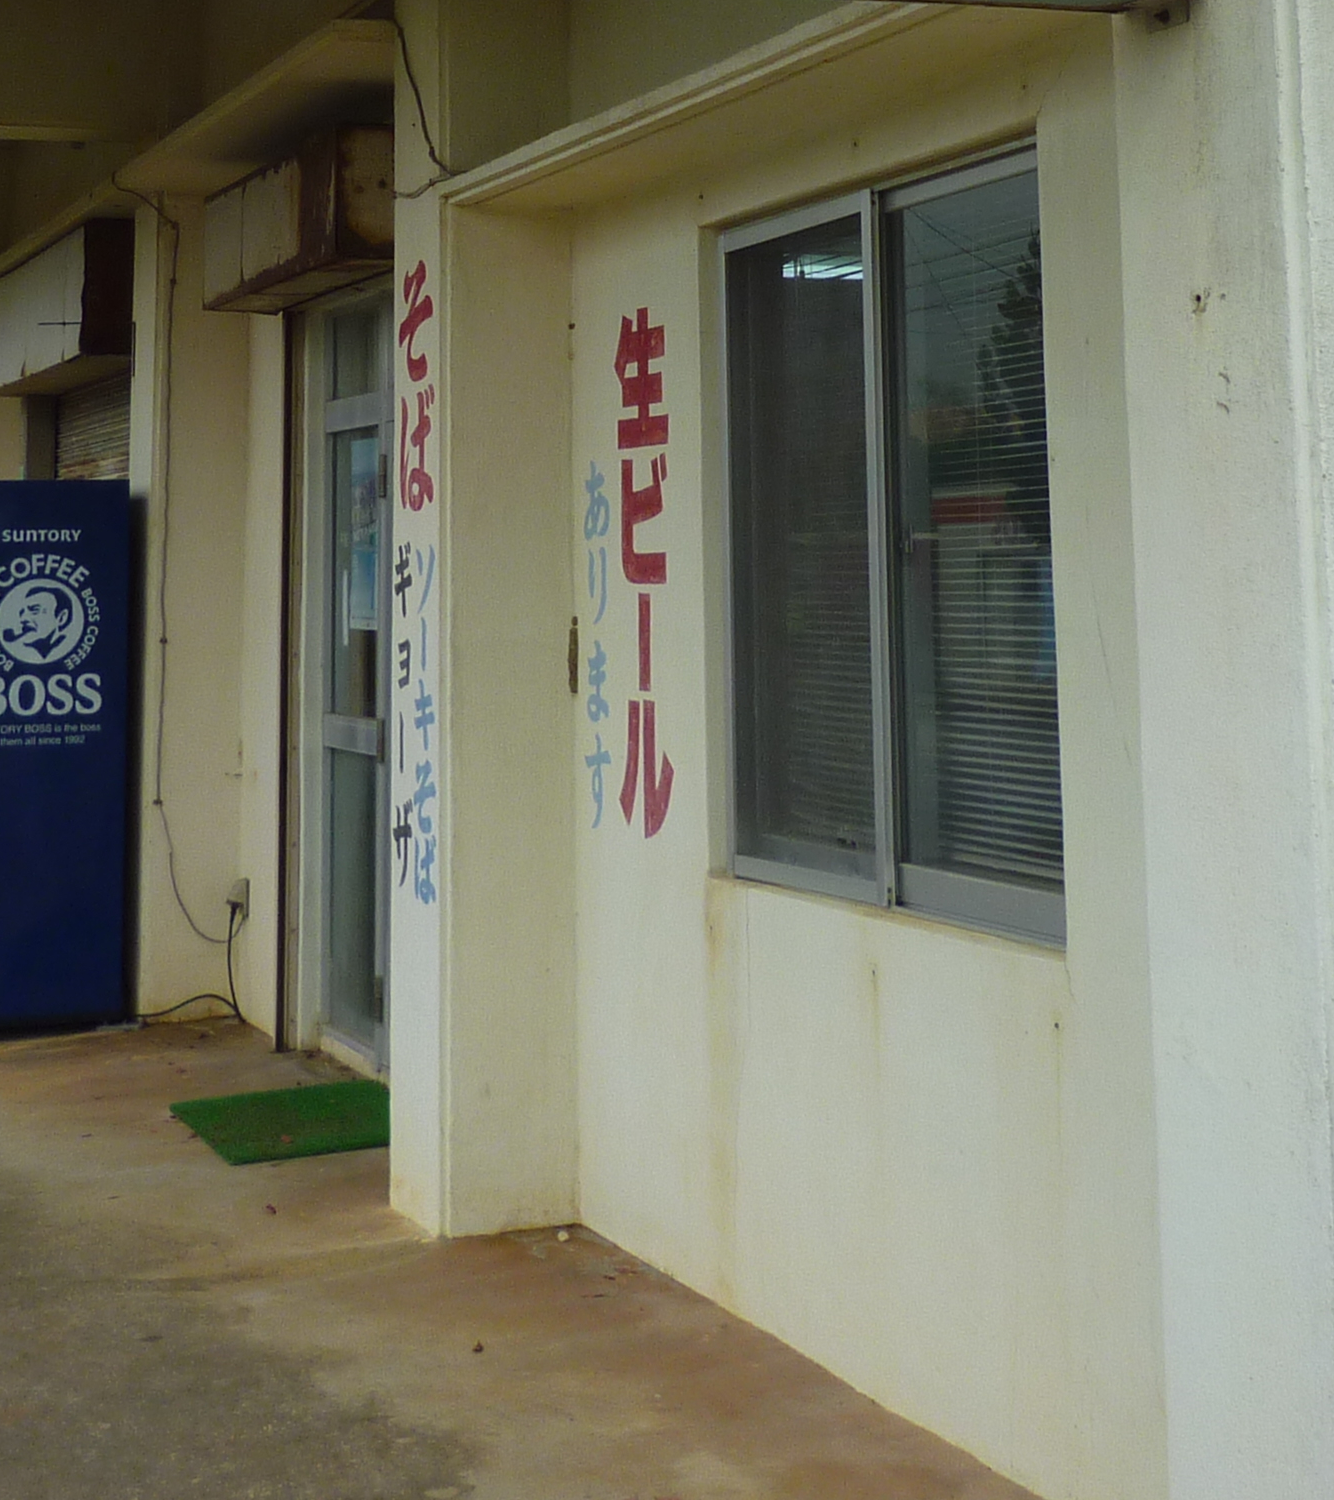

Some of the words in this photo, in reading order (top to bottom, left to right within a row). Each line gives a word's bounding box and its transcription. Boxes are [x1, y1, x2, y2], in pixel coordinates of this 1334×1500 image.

[398, 259, 435, 513] そば
[64, 625, 99, 671] COFFEE
[81, 587, 101, 622] BOSS
[583, 460, 611, 830] あります
[613, 306, 675, 840] 生ビール
[0, 736, 22, 746] them
[38, 736, 62, 745] since
[24, 724, 52, 733] BOSS
[413, 544, 437, 906] ソーキそば
